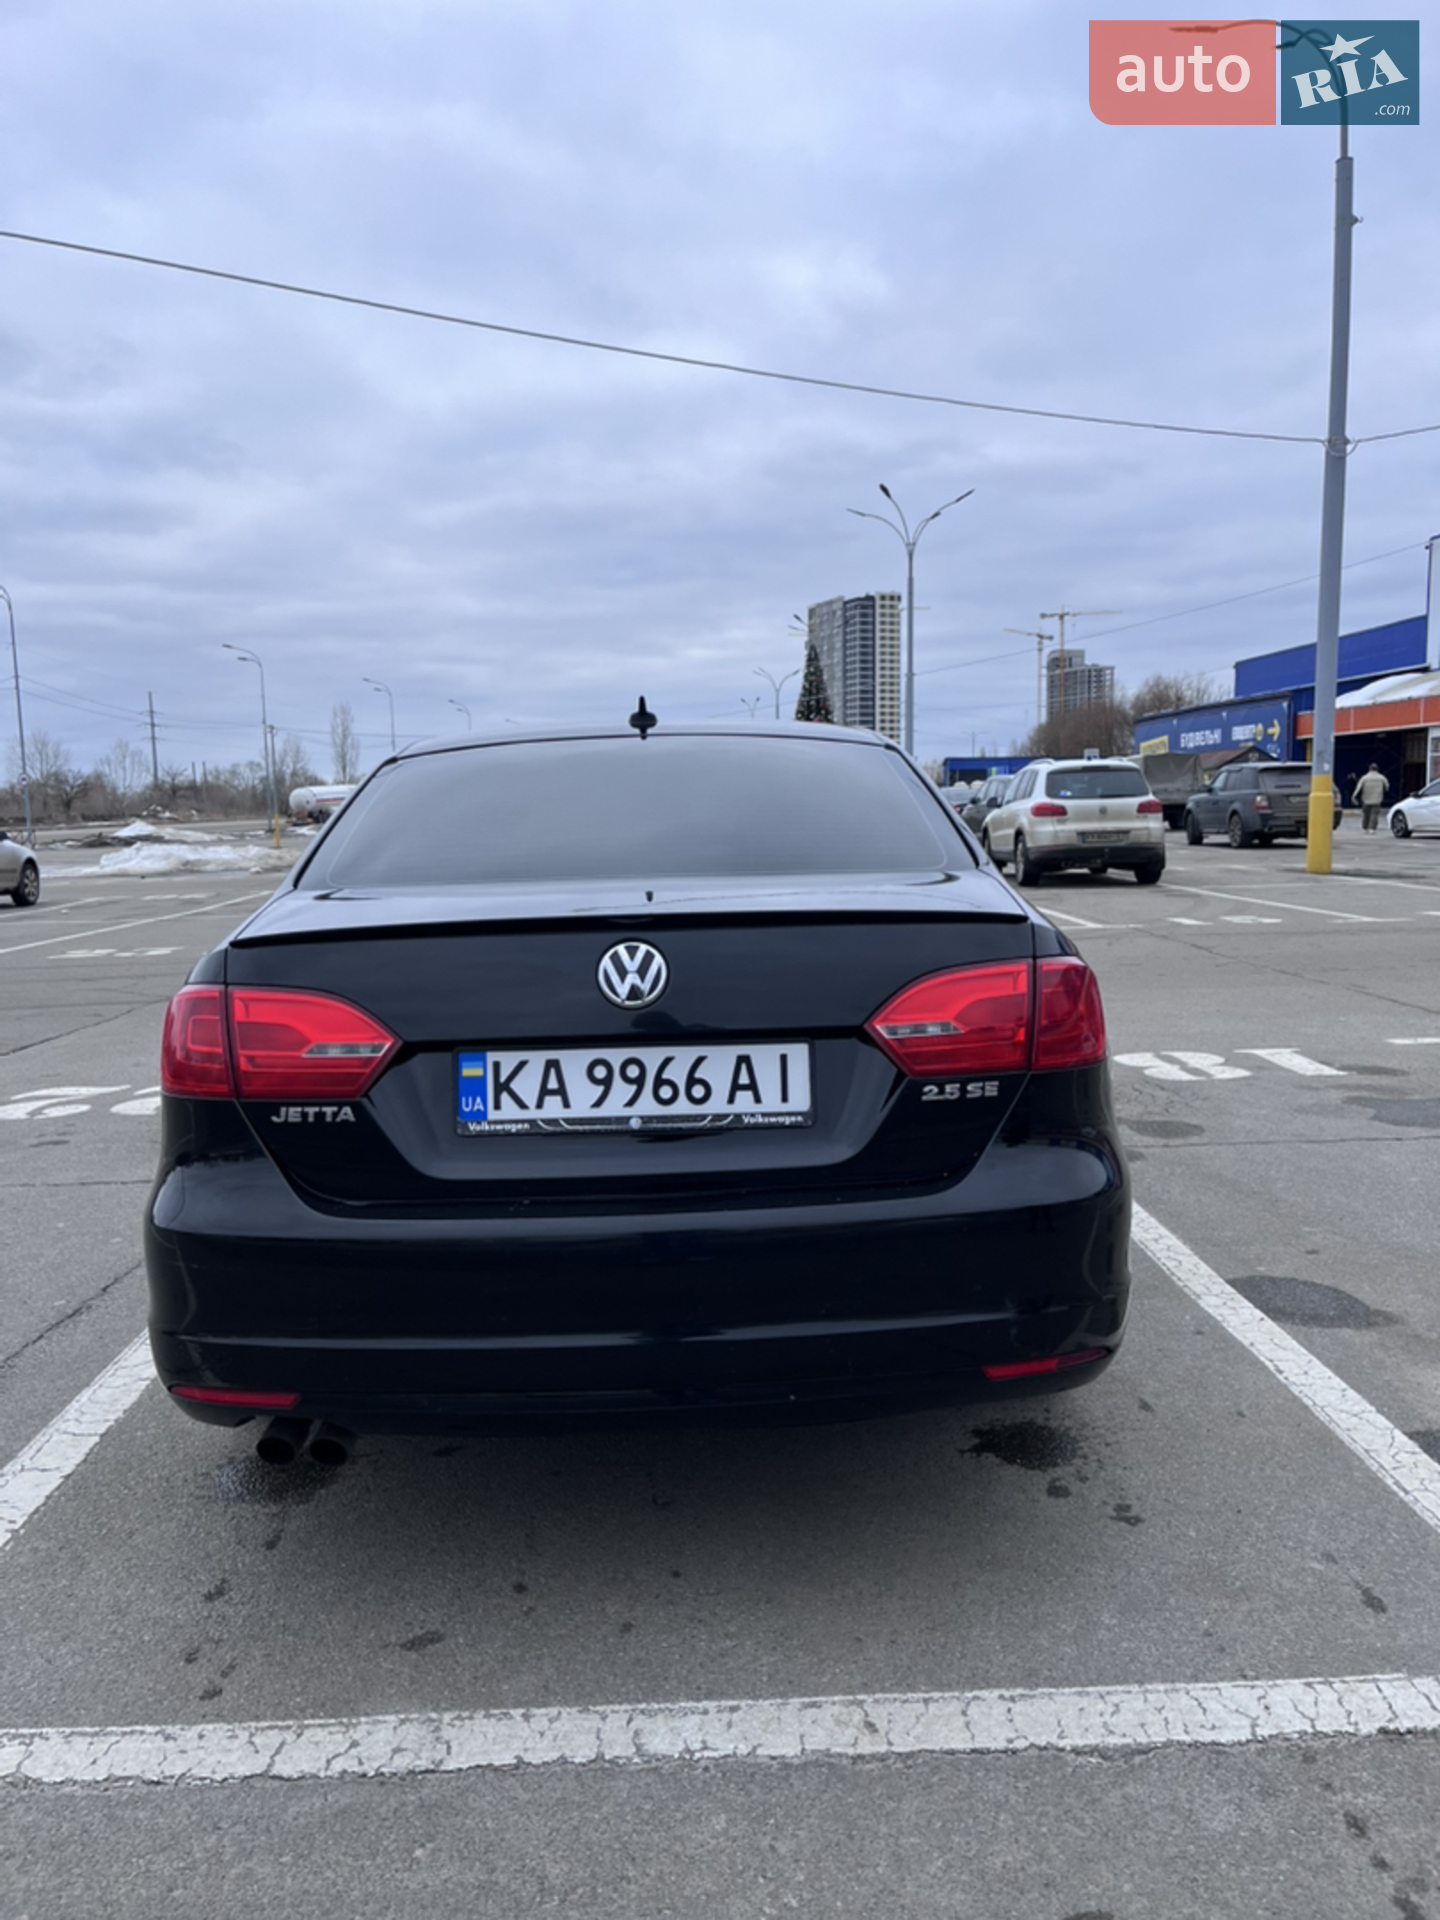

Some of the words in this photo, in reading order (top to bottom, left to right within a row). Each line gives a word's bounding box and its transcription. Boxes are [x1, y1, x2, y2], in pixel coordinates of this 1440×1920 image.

[492, 1058, 571, 1111] KA
[586, 1055, 713, 1109] 9966
[727, 1053, 788, 1105] AI
[966, 1081, 1000, 1098] SE
[462, 1097, 484, 1113] UA
[270, 1106, 356, 1123] JETTA
[742, 1113, 804, 1125] Volkswagen
[467, 1119, 531, 1132] Volkswagen
